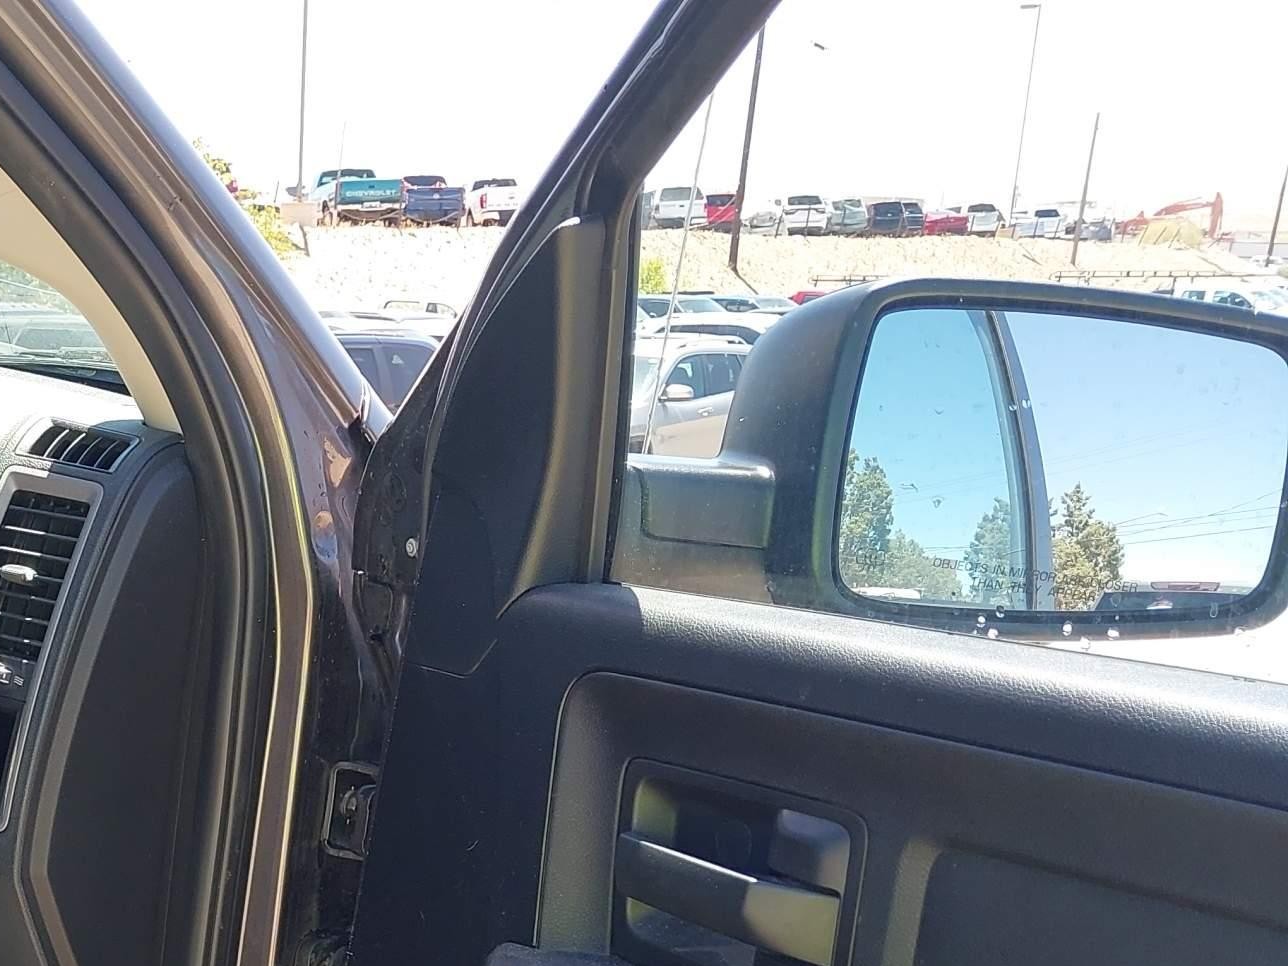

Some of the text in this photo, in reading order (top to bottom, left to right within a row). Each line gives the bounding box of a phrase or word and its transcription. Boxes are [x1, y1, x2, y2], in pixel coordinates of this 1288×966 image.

[932, 557, 988, 574] OBJECTS
[992, 563, 1007, 576] IN
[971, 576, 1004, 590] THAN
[1010, 581, 1042, 593] THY
